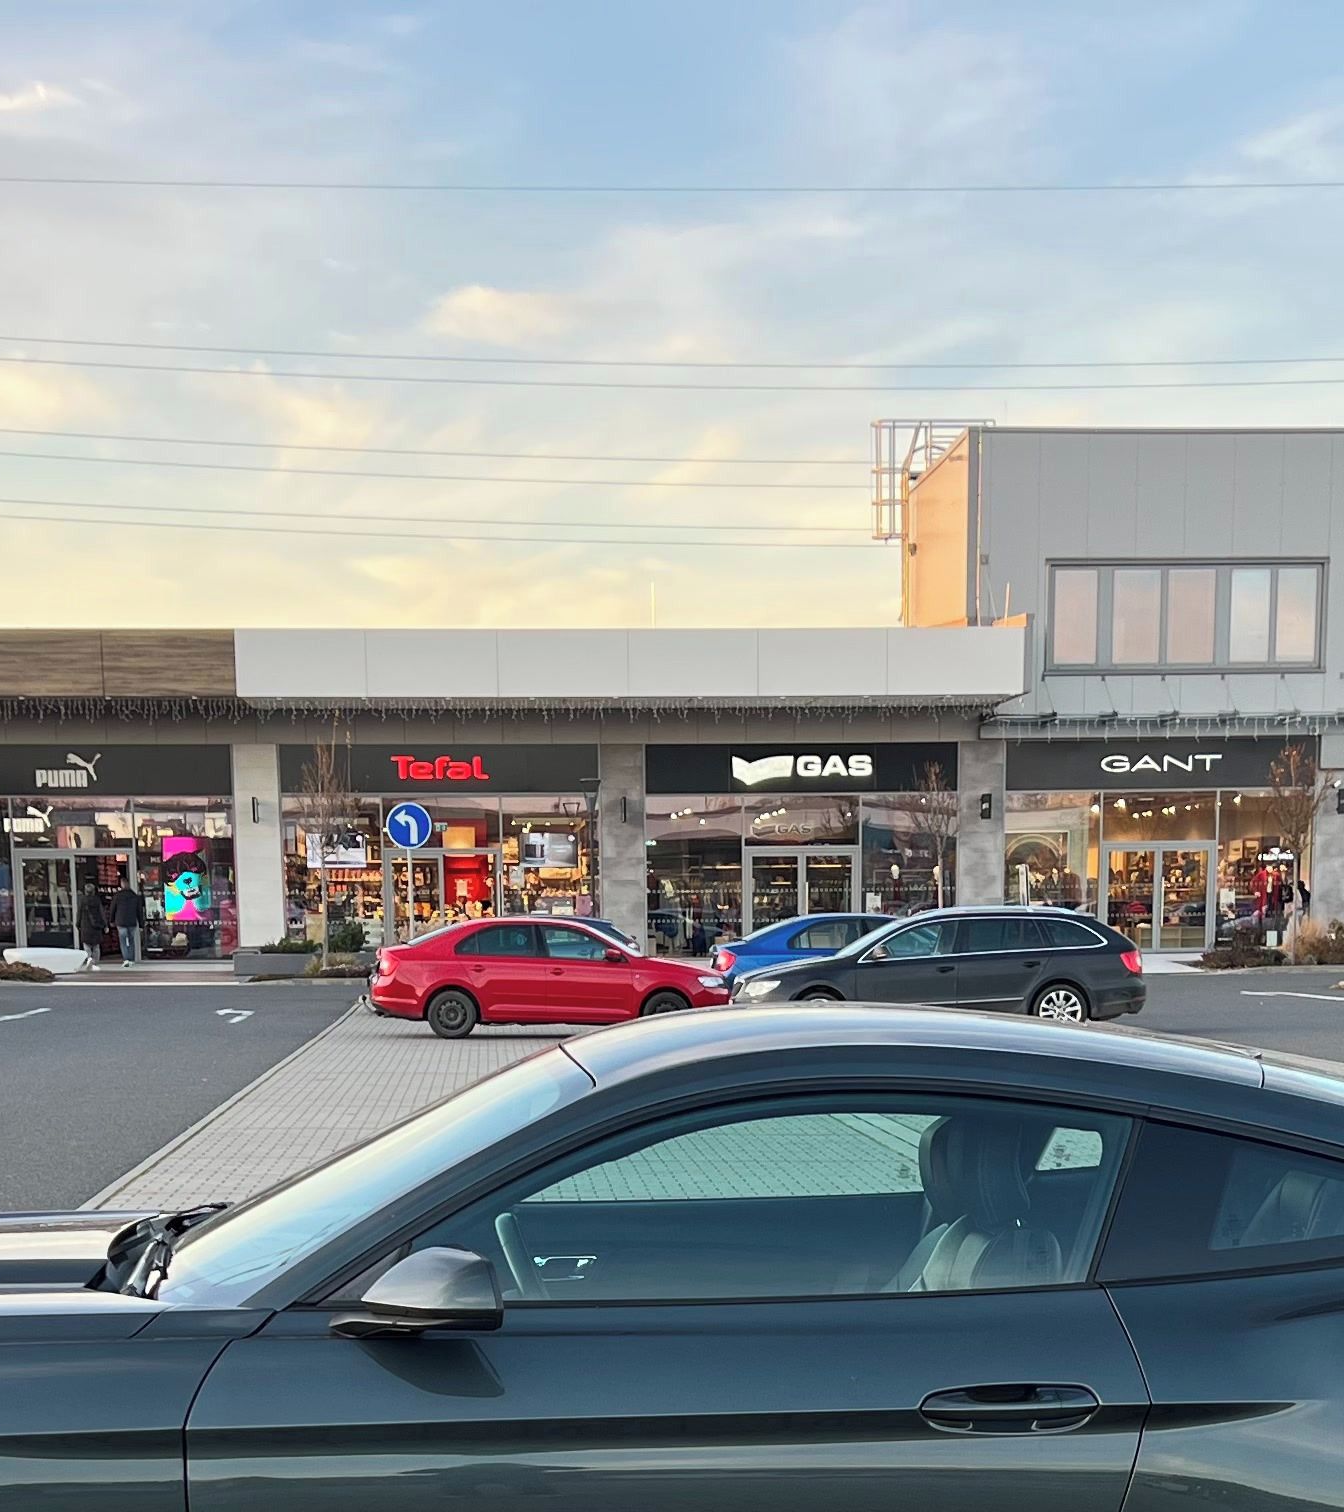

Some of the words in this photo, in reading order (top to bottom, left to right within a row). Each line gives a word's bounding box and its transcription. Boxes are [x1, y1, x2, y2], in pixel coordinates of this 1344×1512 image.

[390, 755, 490, 780] Tefal
[796, 754, 873, 777] GAS
[1100, 753, 1223, 773] GANT
[35, 769, 88, 788] PUMA
[776, 824, 811, 835] GAS
